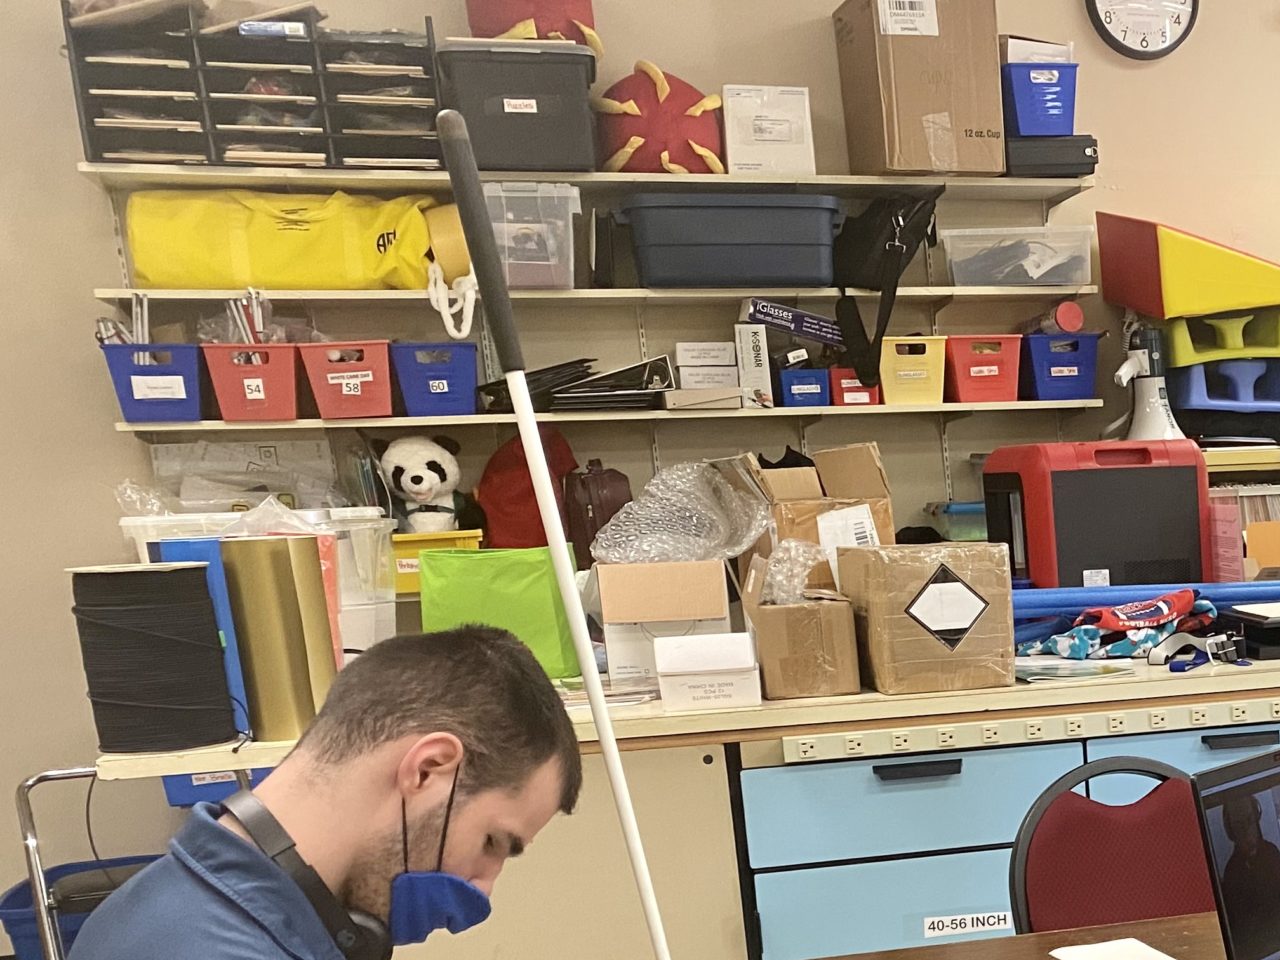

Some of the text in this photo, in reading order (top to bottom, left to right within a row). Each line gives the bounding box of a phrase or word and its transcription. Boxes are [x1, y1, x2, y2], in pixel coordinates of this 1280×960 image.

[1104, 10, 1113, 25] 8
[1173, 14, 1182, 26] 4
[1120, 29, 1128, 42] 7
[1140, 36, 1149, 49] 6
[963, 128, 1001, 140] 12 oz. Cup
[756, 301, 793, 320] iGlasses
[246, 384, 262, 395] 54
[345, 382, 360, 393] 58
[431, 381, 445, 392] 60
[927, 913, 1007, 932] 40-56 INCH
